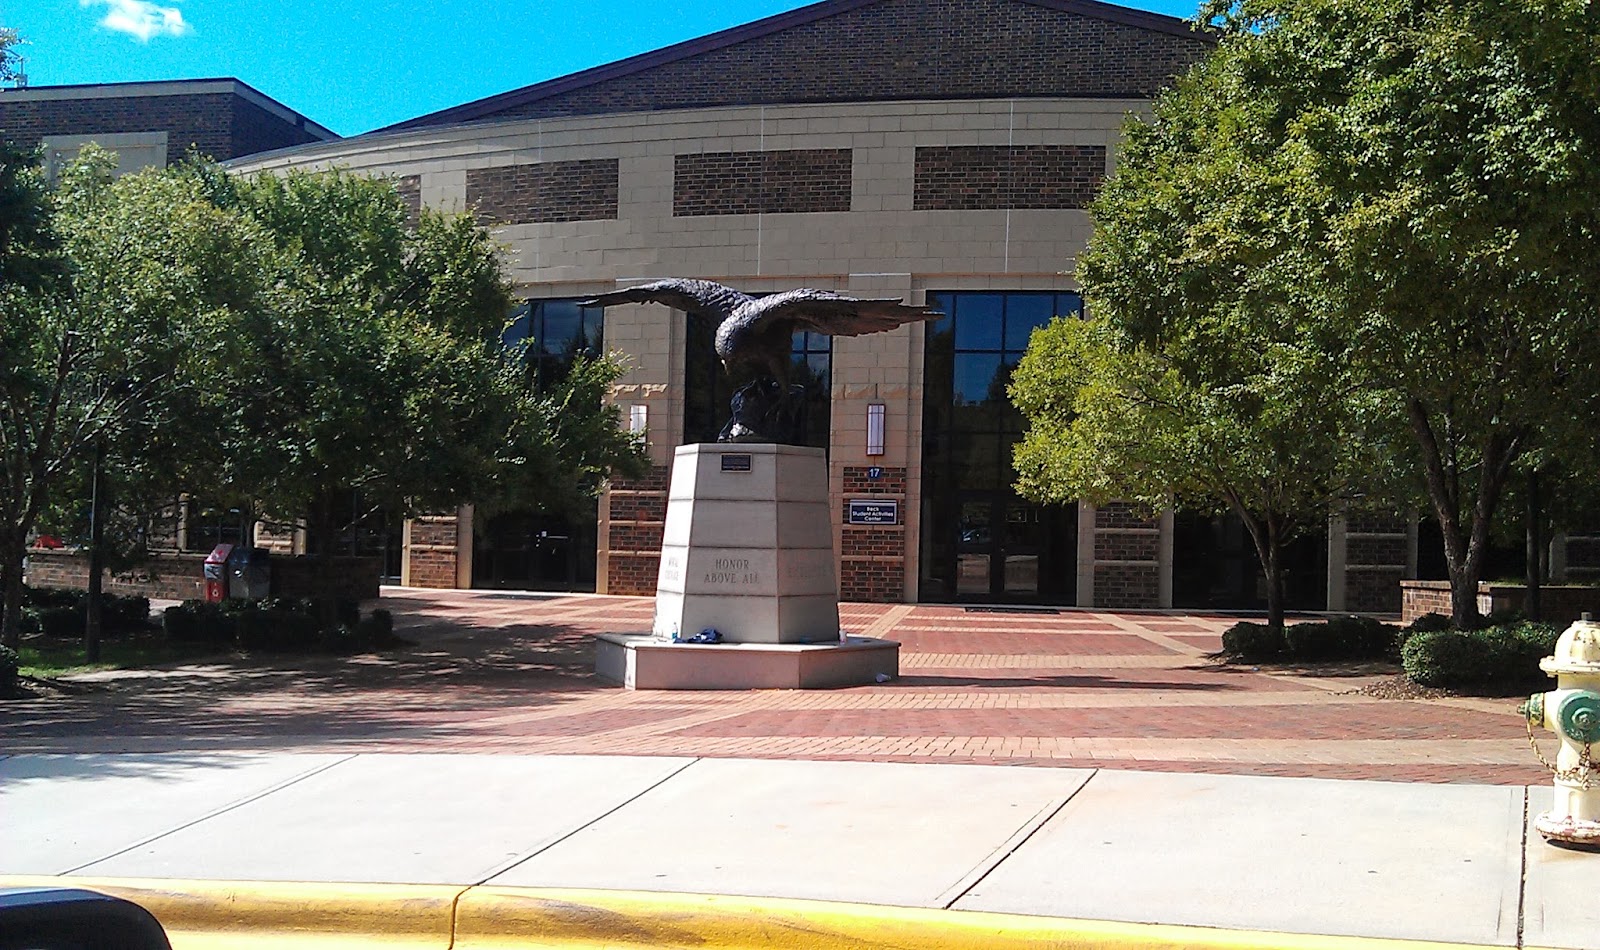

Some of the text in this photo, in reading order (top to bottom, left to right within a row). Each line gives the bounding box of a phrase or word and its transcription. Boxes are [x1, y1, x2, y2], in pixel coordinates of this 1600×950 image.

[869, 468, 880, 477] 17
[715, 558, 749, 570] HONOR
[703, 572, 760, 584] ABOVE ALL
